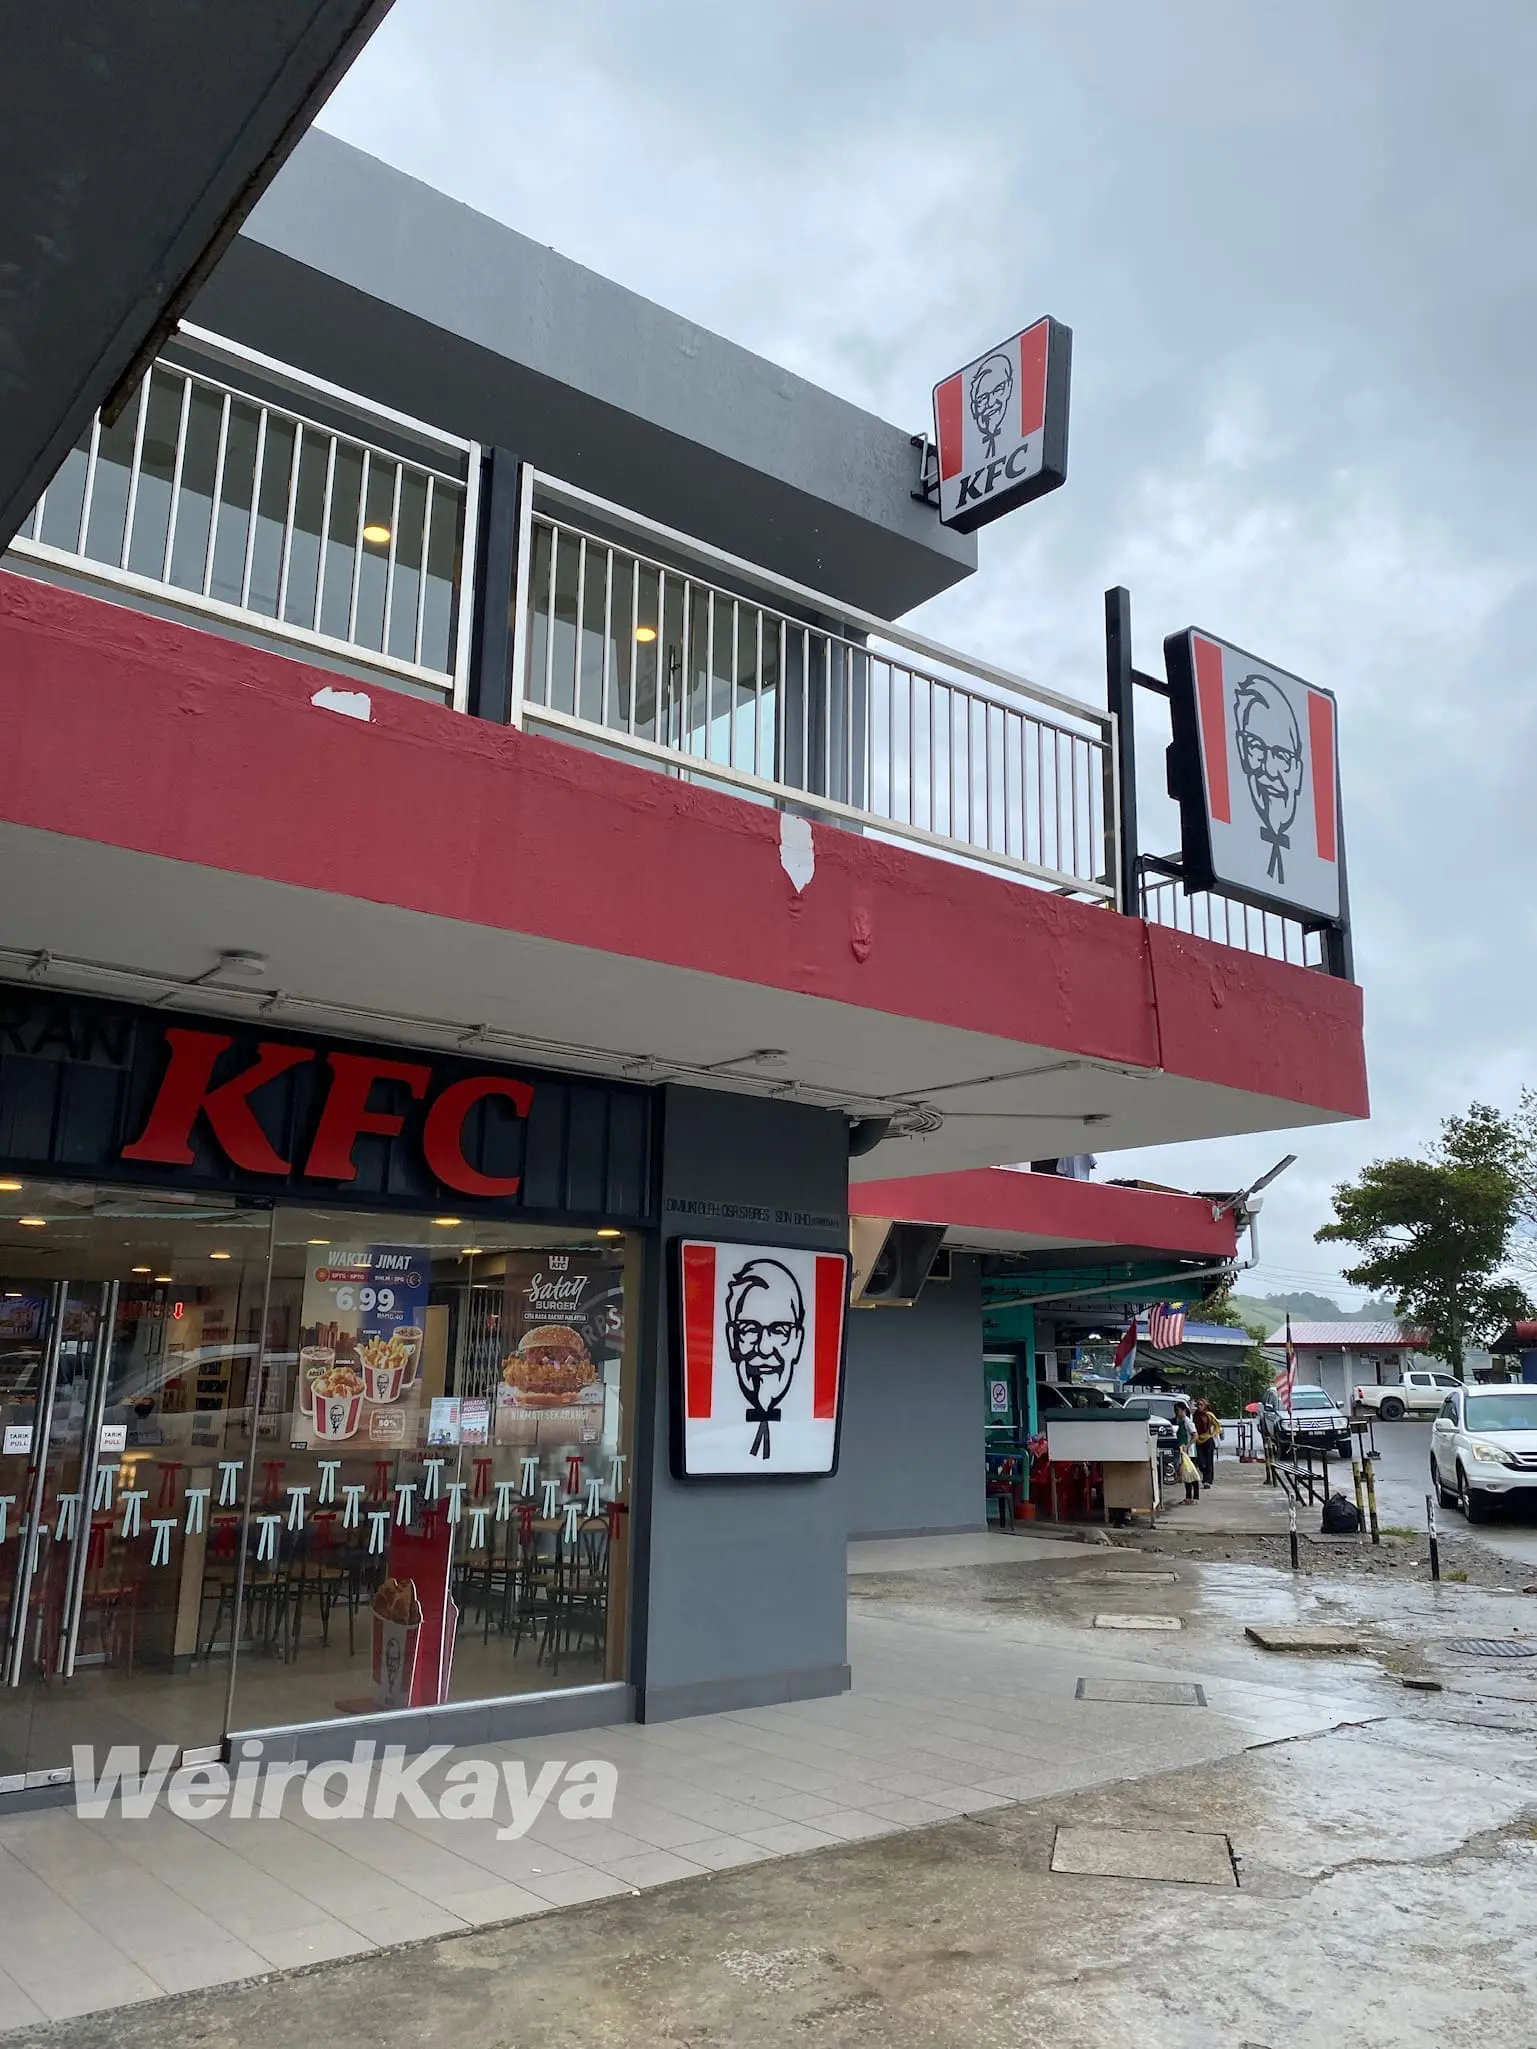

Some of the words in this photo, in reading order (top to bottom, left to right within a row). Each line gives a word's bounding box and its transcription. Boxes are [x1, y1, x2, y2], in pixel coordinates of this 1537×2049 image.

[955, 444, 1029, 509] KFC
[120, 1028, 535, 1197] KFC
[328, 1251, 372, 1267] WAKTU
[375, 1255, 412, 1270] JIMAT
[336, 1286, 395, 1312] 6.99
[522, 1273, 589, 1304] Satay
[535, 1301, 576, 1311] BURGER
[511, 1409, 542, 1420] NIKMATI
